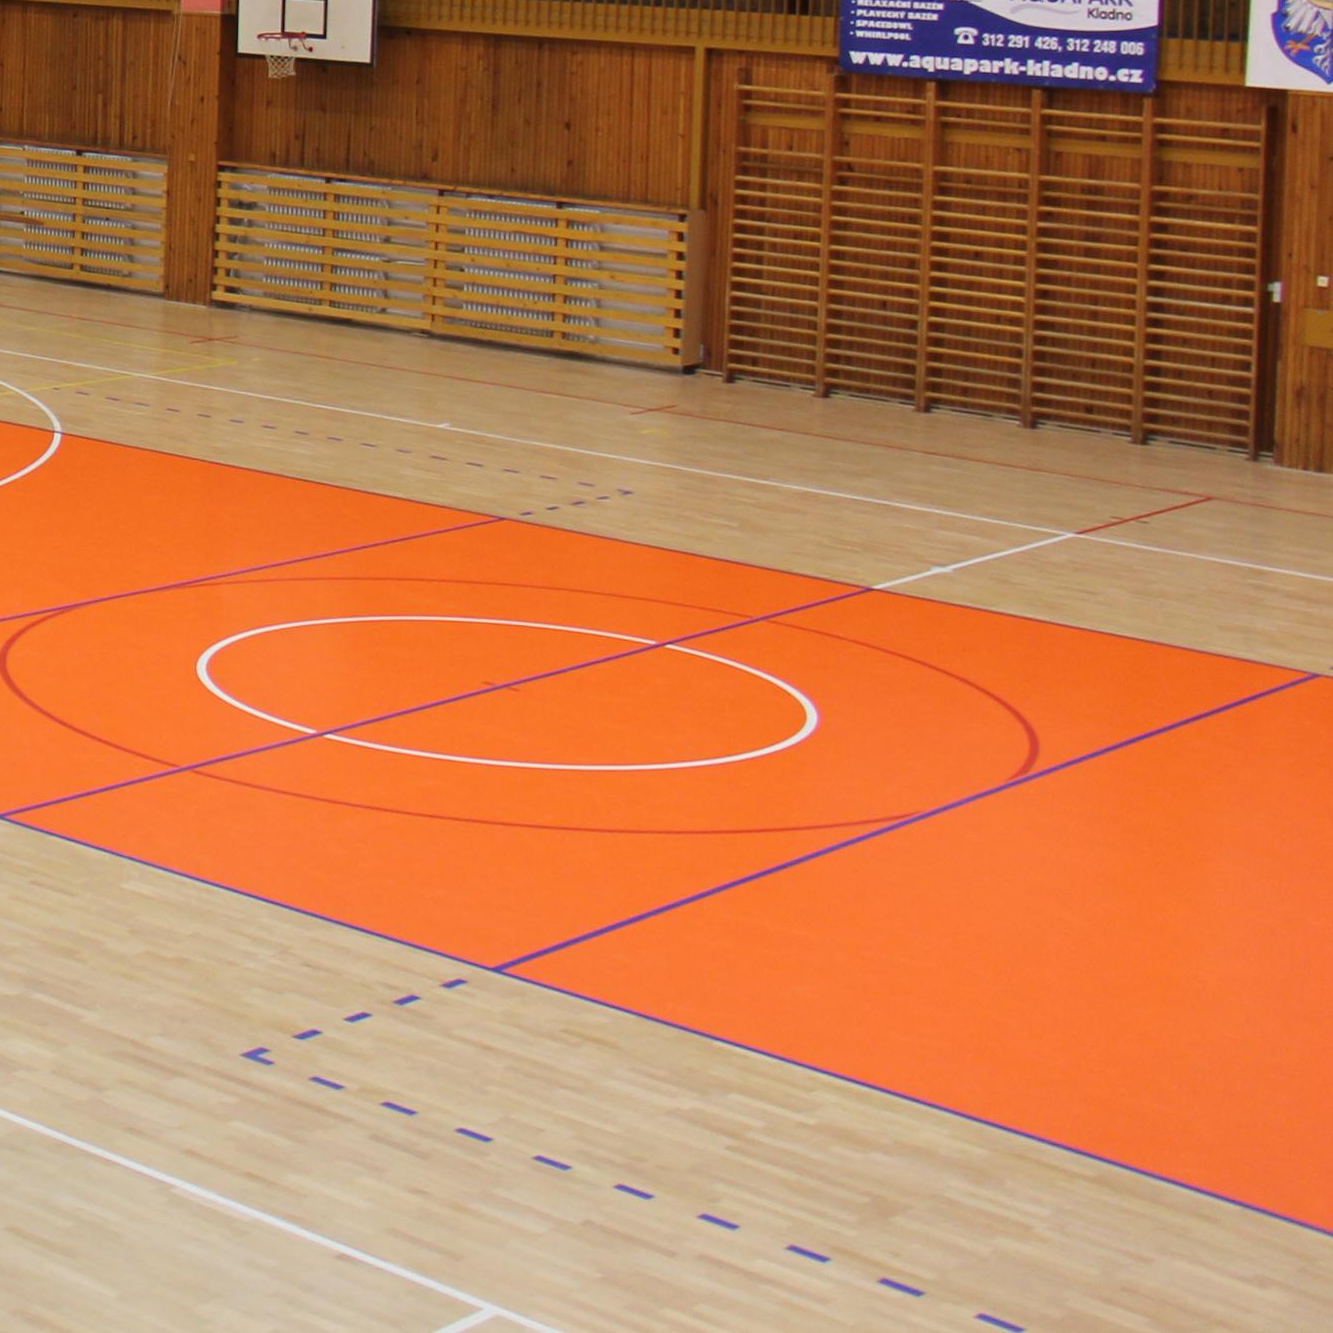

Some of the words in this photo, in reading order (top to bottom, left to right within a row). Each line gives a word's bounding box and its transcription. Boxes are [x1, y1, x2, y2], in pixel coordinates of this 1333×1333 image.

[1087, 7, 1133, 22] Kladno
[855, 29, 912, 41] WHIRLPOOL
[982, 33, 1004, 47] 312
[1008, 34, 1030, 48] 291
[1066, 38, 1090, 52] 312
[1093, 40, 1117, 54] 248
[1120, 41, 1145, 56] 006
[848, 50, 1144, 84] www.aquapark-kladno.cz
